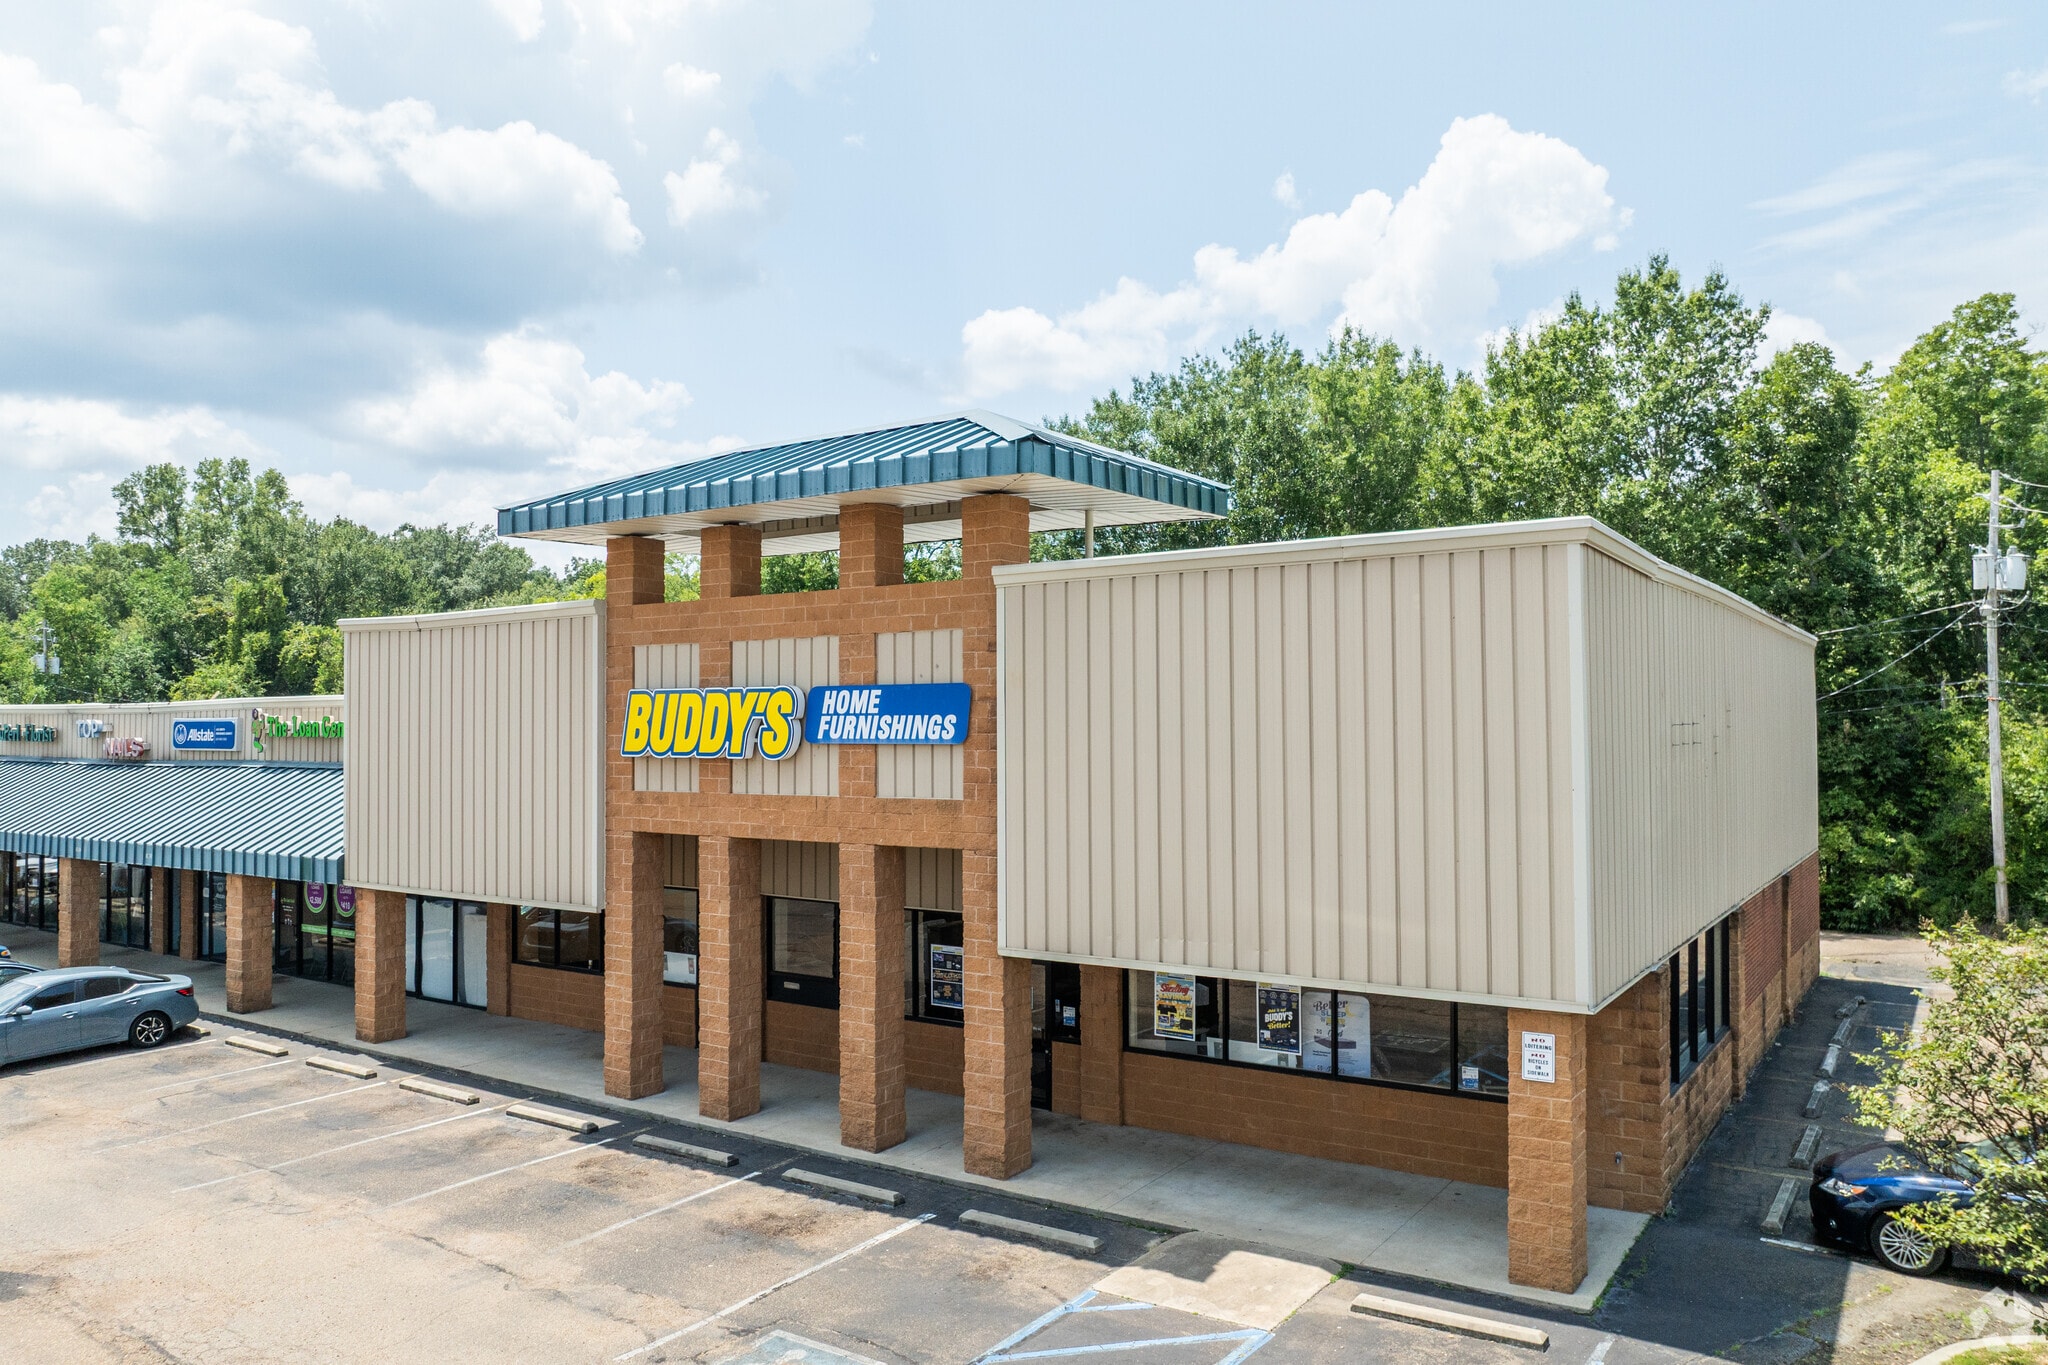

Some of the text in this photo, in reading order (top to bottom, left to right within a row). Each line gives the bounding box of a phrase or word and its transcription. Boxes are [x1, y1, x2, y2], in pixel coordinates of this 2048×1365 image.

[822, 690, 882, 714] HOME
[76, 720, 98, 738] TOP
[267, 716, 288, 737] The
[292, 716, 320, 738] Loan
[622, 687, 799, 758] BUDDY'S
[817, 715, 957, 741] FURNISHINGS
[25, 723, 54, 742] Florist
[187, 728, 214, 741] Allstate
[104, 738, 143, 757] NAILS
[1313, 1001, 1348, 1011] Beer
[1321, 1010, 1347, 1018] SLEP
[1264, 1011, 1293, 1023] BUDDY'S
